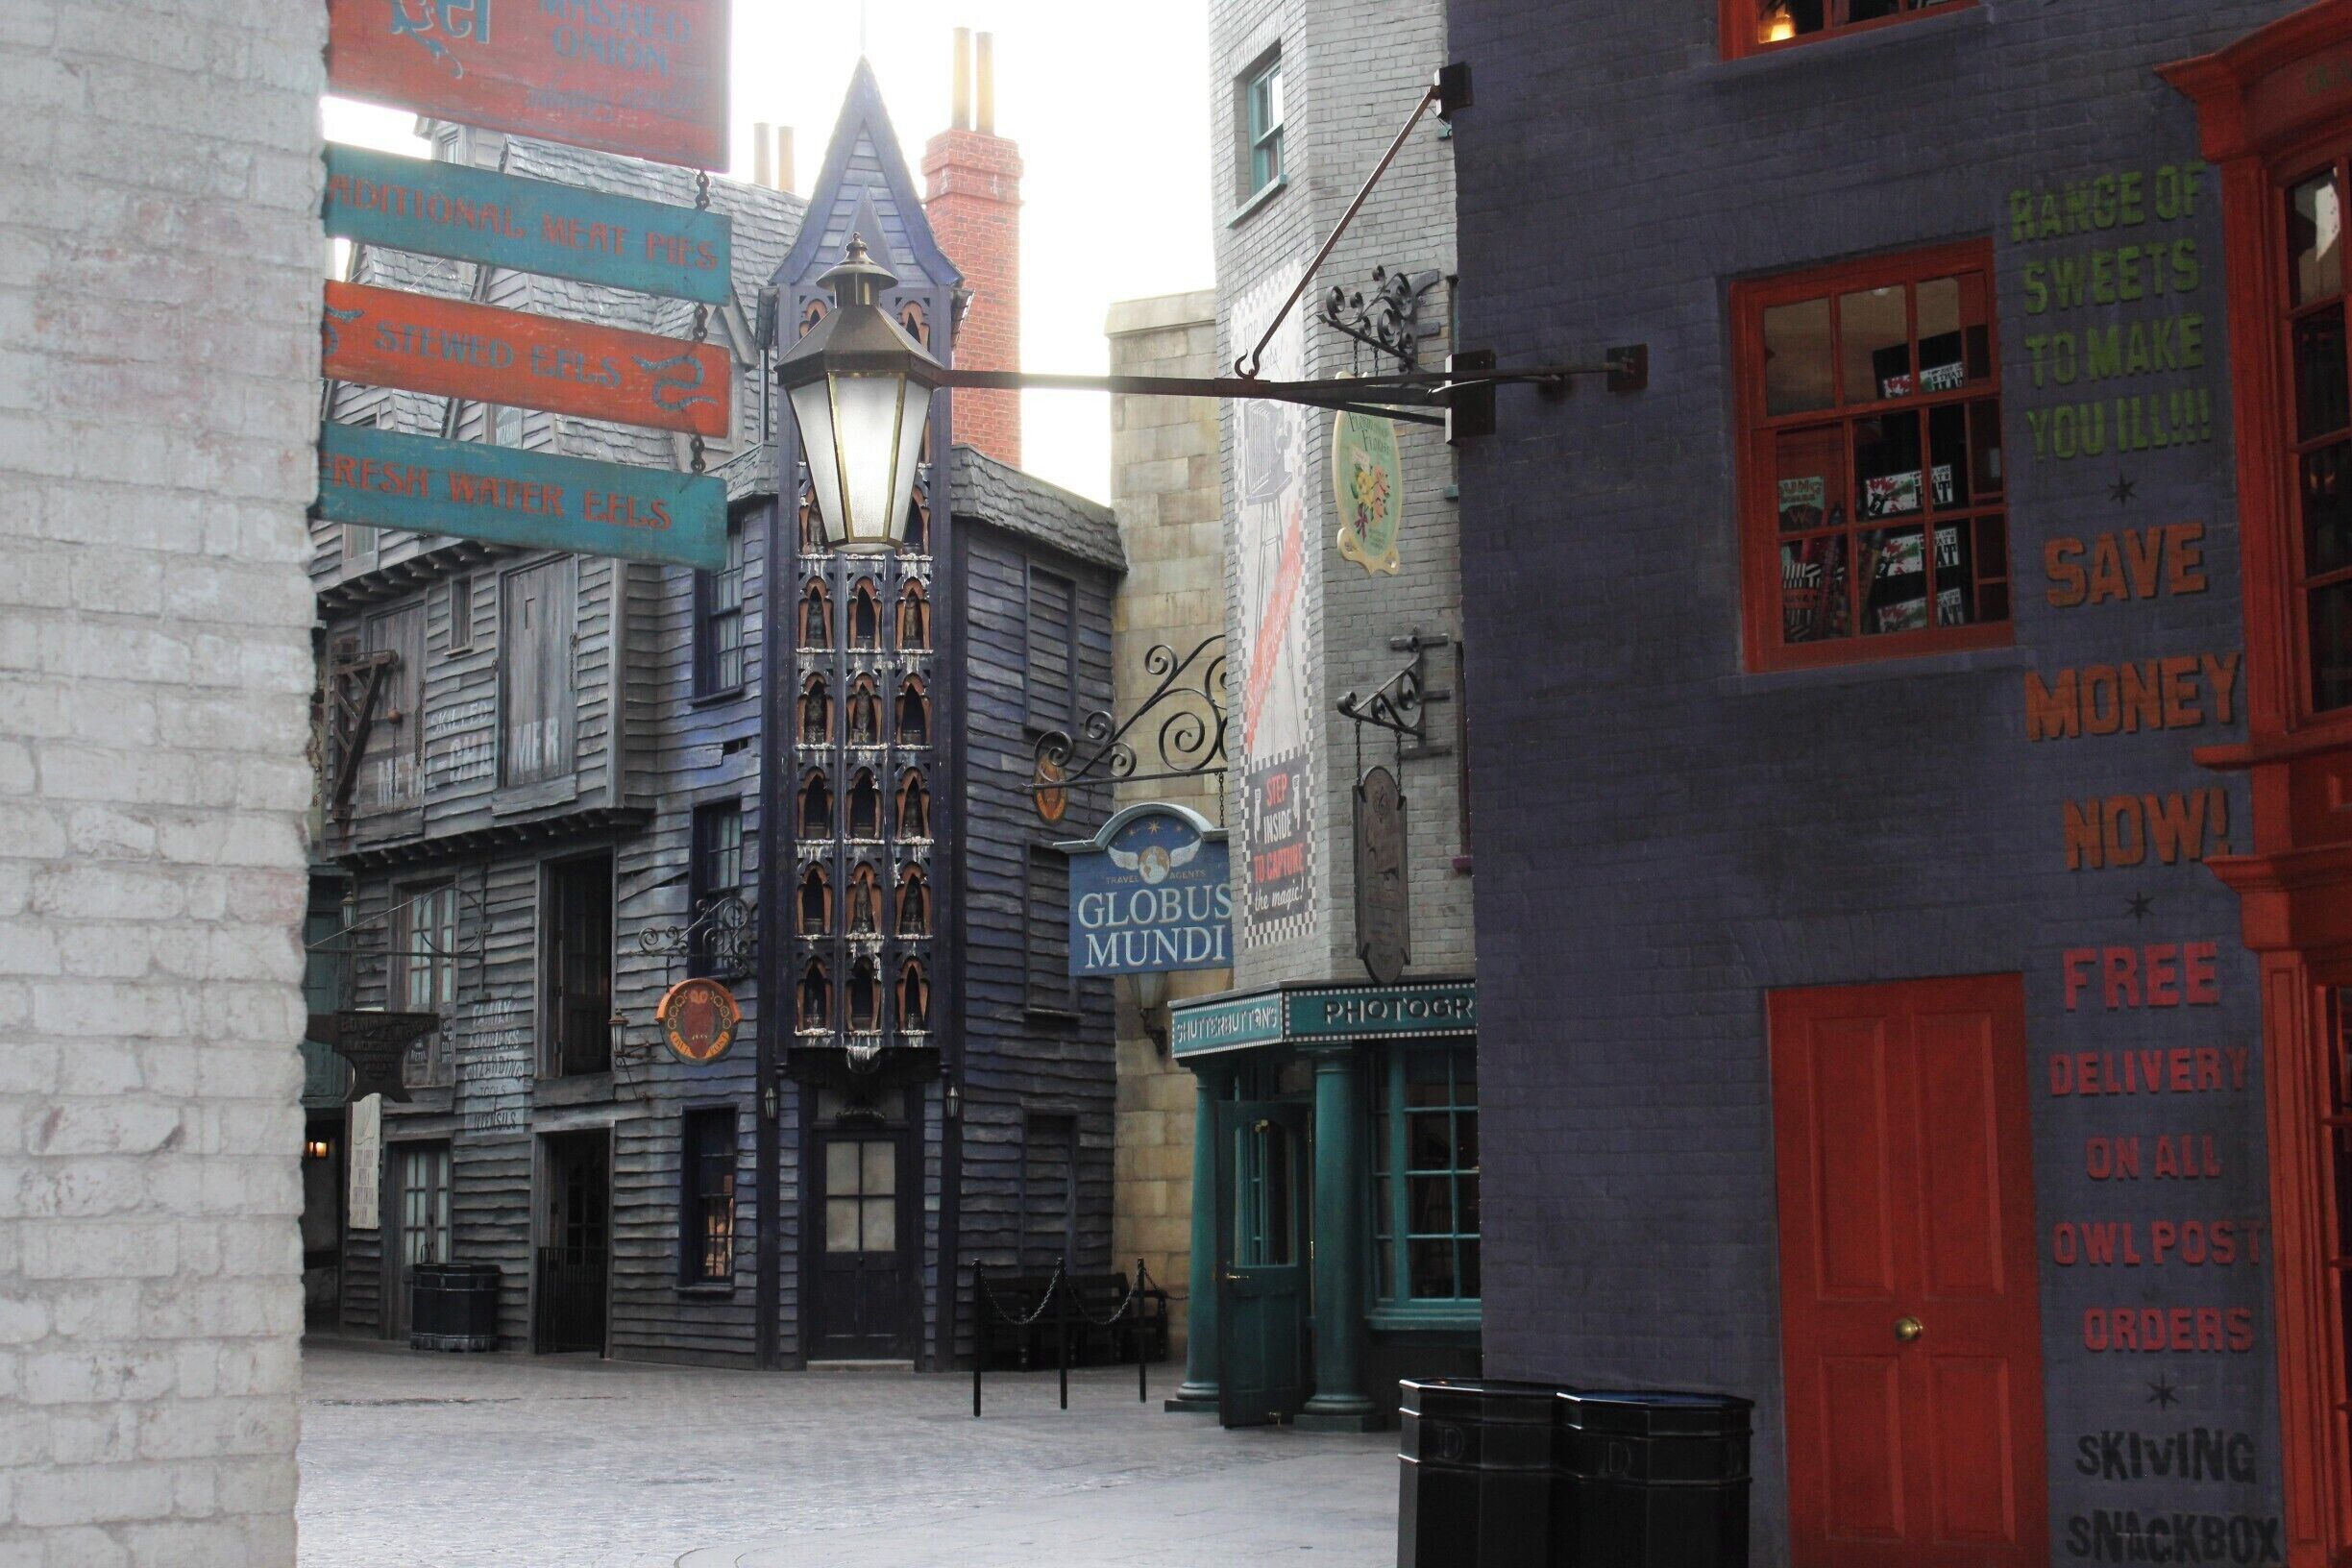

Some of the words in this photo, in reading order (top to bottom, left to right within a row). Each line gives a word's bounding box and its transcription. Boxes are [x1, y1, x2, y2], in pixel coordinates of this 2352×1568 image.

[552, 23, 670, 76] ONION
[2009, 171, 2144, 244] RANGE
[2154, 159, 2208, 222] OF
[540, 213, 628, 256] MEAT
[646, 231, 718, 272] PIES
[2022, 239, 2199, 314] SWEETS
[373, 320, 514, 370] STEWED
[531, 344, 622, 388] EELS
[2024, 331, 2076, 390] TO
[2087, 312, 2206, 382] MAKE
[2027, 401, 2107, 464] YOU
[448, 470, 565, 518] WATER
[583, 491, 673, 532] EELS
[2044, 522, 2208, 608] SAVE
[2024, 651, 2242, 744] MONEY
[1266, 772, 1289, 807] STEP
[1263, 808, 1293, 845] INSIDE
[2063, 788, 2231, 871] NOW!
[1106, 874, 1140, 885] TRAVEL
[1168, 869, 1207, 880] AGENTS
[1254, 852, 1264, 884] TO
[1266, 842, 1305, 883] CAPTURE
[1077, 883, 1233, 929] GLOBUS
[1254, 887, 1269, 912] the
[1271, 876, 1305, 911] magic!
[1085, 925, 1227, 969] MUNDI
[2063, 942, 2221, 1012] FREE
[1325, 995, 1474, 1025] PHOTOGR
[479, 1085, 506, 1096] TOOLS
[2049, 1046, 2249, 1096] DELIVERY
[476, 1112, 517, 1133] UTENSILS
[2086, 1136, 2140, 1180] ON
[2153, 1133, 2221, 1180] ALL
[2052, 1221, 2143, 1266] OWL
[2151, 1219, 2264, 1266] POST
[2083, 1306, 2254, 1353] ORDERS
[2074, 1427, 2257, 1483] SKIVING
